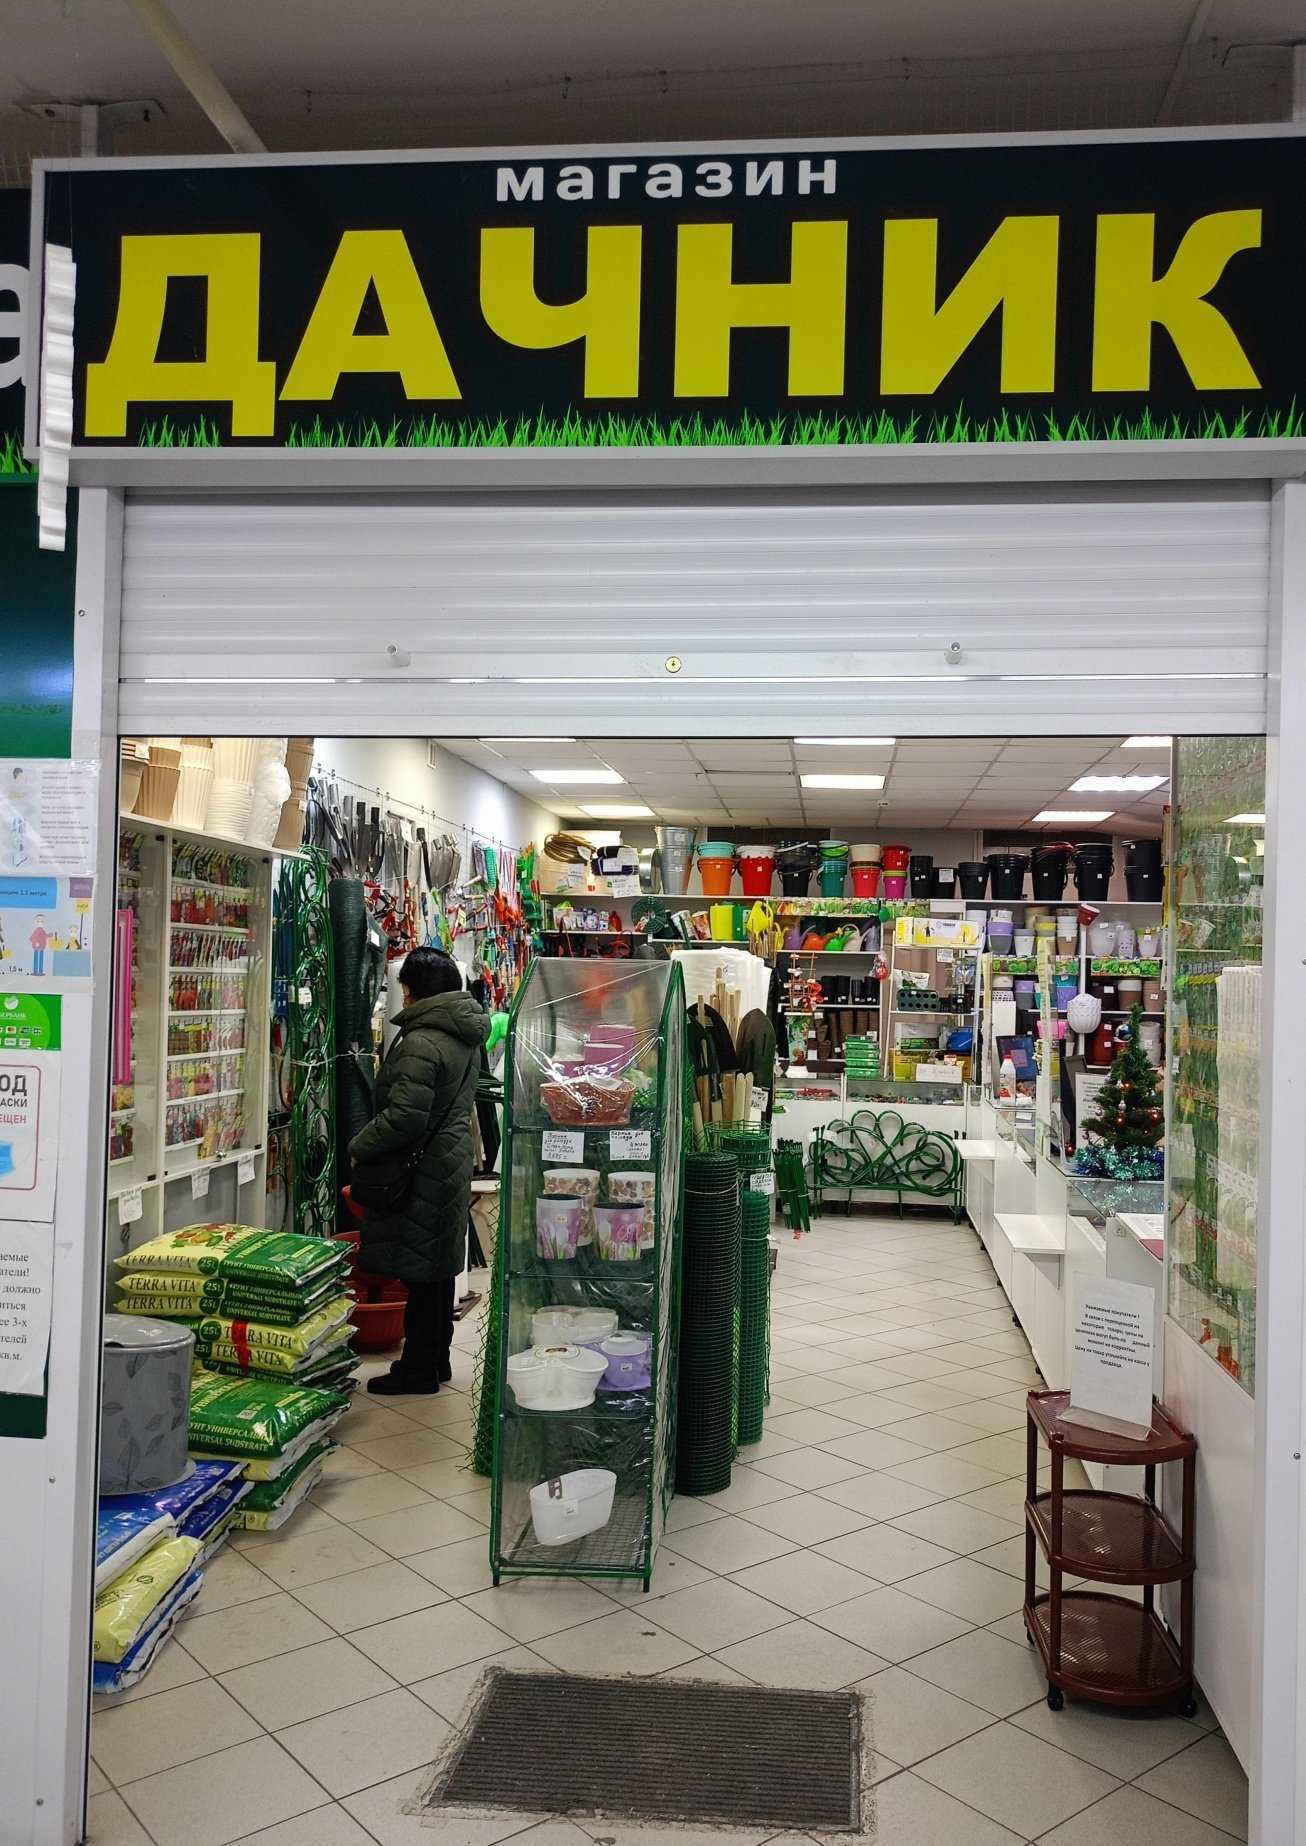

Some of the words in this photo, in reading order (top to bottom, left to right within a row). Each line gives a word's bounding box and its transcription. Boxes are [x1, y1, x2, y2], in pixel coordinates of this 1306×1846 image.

[496, 159, 837, 202] магазин
[85, 208, 1263, 438] ДАЧНИК
[126, 1255, 166, 1266] TERRA
[2, 1286, 41, 1294] должно
[129, 1277, 169, 1291] TERRA
[170, 1279, 196, 1292] VITA
[127, 1297, 166, 1310] TERRA
[168, 1297, 192, 1309] VITA
[225, 1326, 262, 1343] TRA
[267, 1332, 292, 1349] VITA
[216, 1344, 253, 1361] TERA
[256, 1350, 281, 1366] VITA
[225, 1438, 268, 1452] SUBSTRATE
